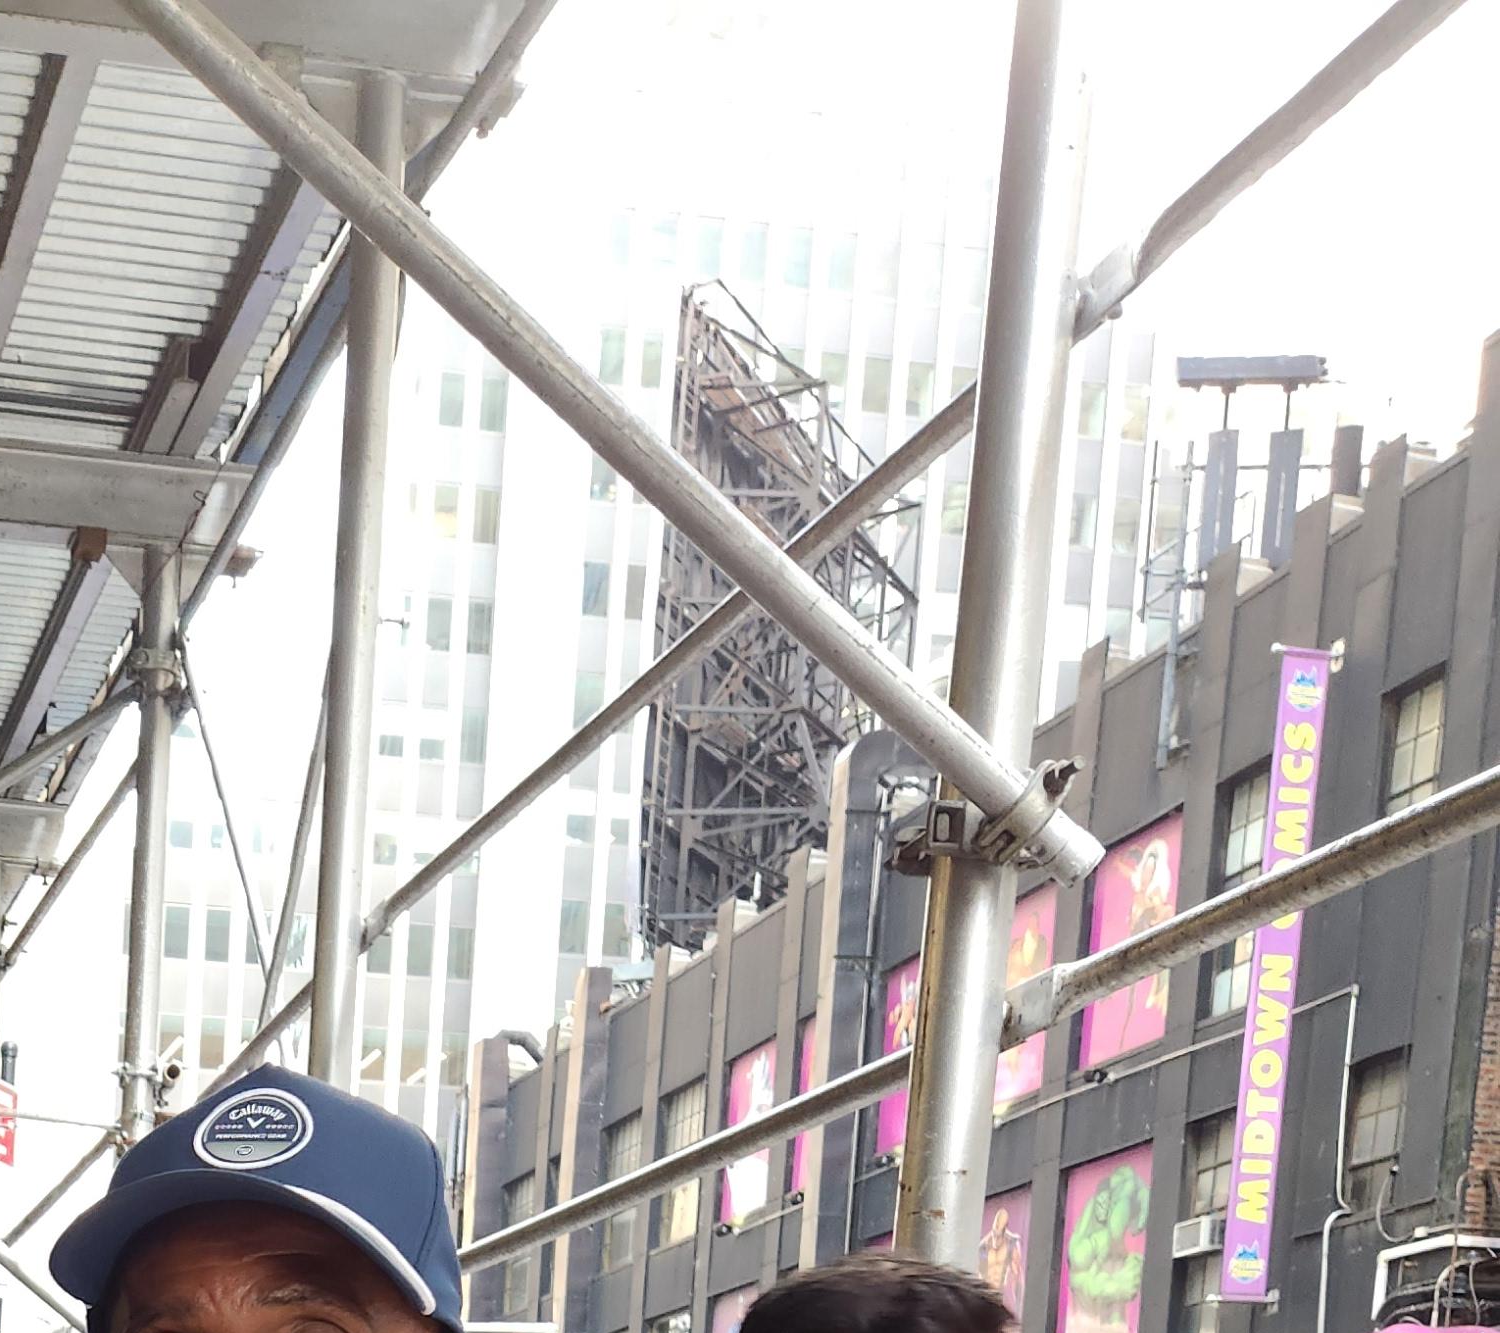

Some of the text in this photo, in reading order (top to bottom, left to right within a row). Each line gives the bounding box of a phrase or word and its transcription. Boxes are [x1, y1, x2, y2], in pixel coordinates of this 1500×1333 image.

[1236, 953, 1295, 1225] MIDTOWN
[1272, 721, 1317, 930] MICS
[229, 1104, 287, 1121] Callaway
